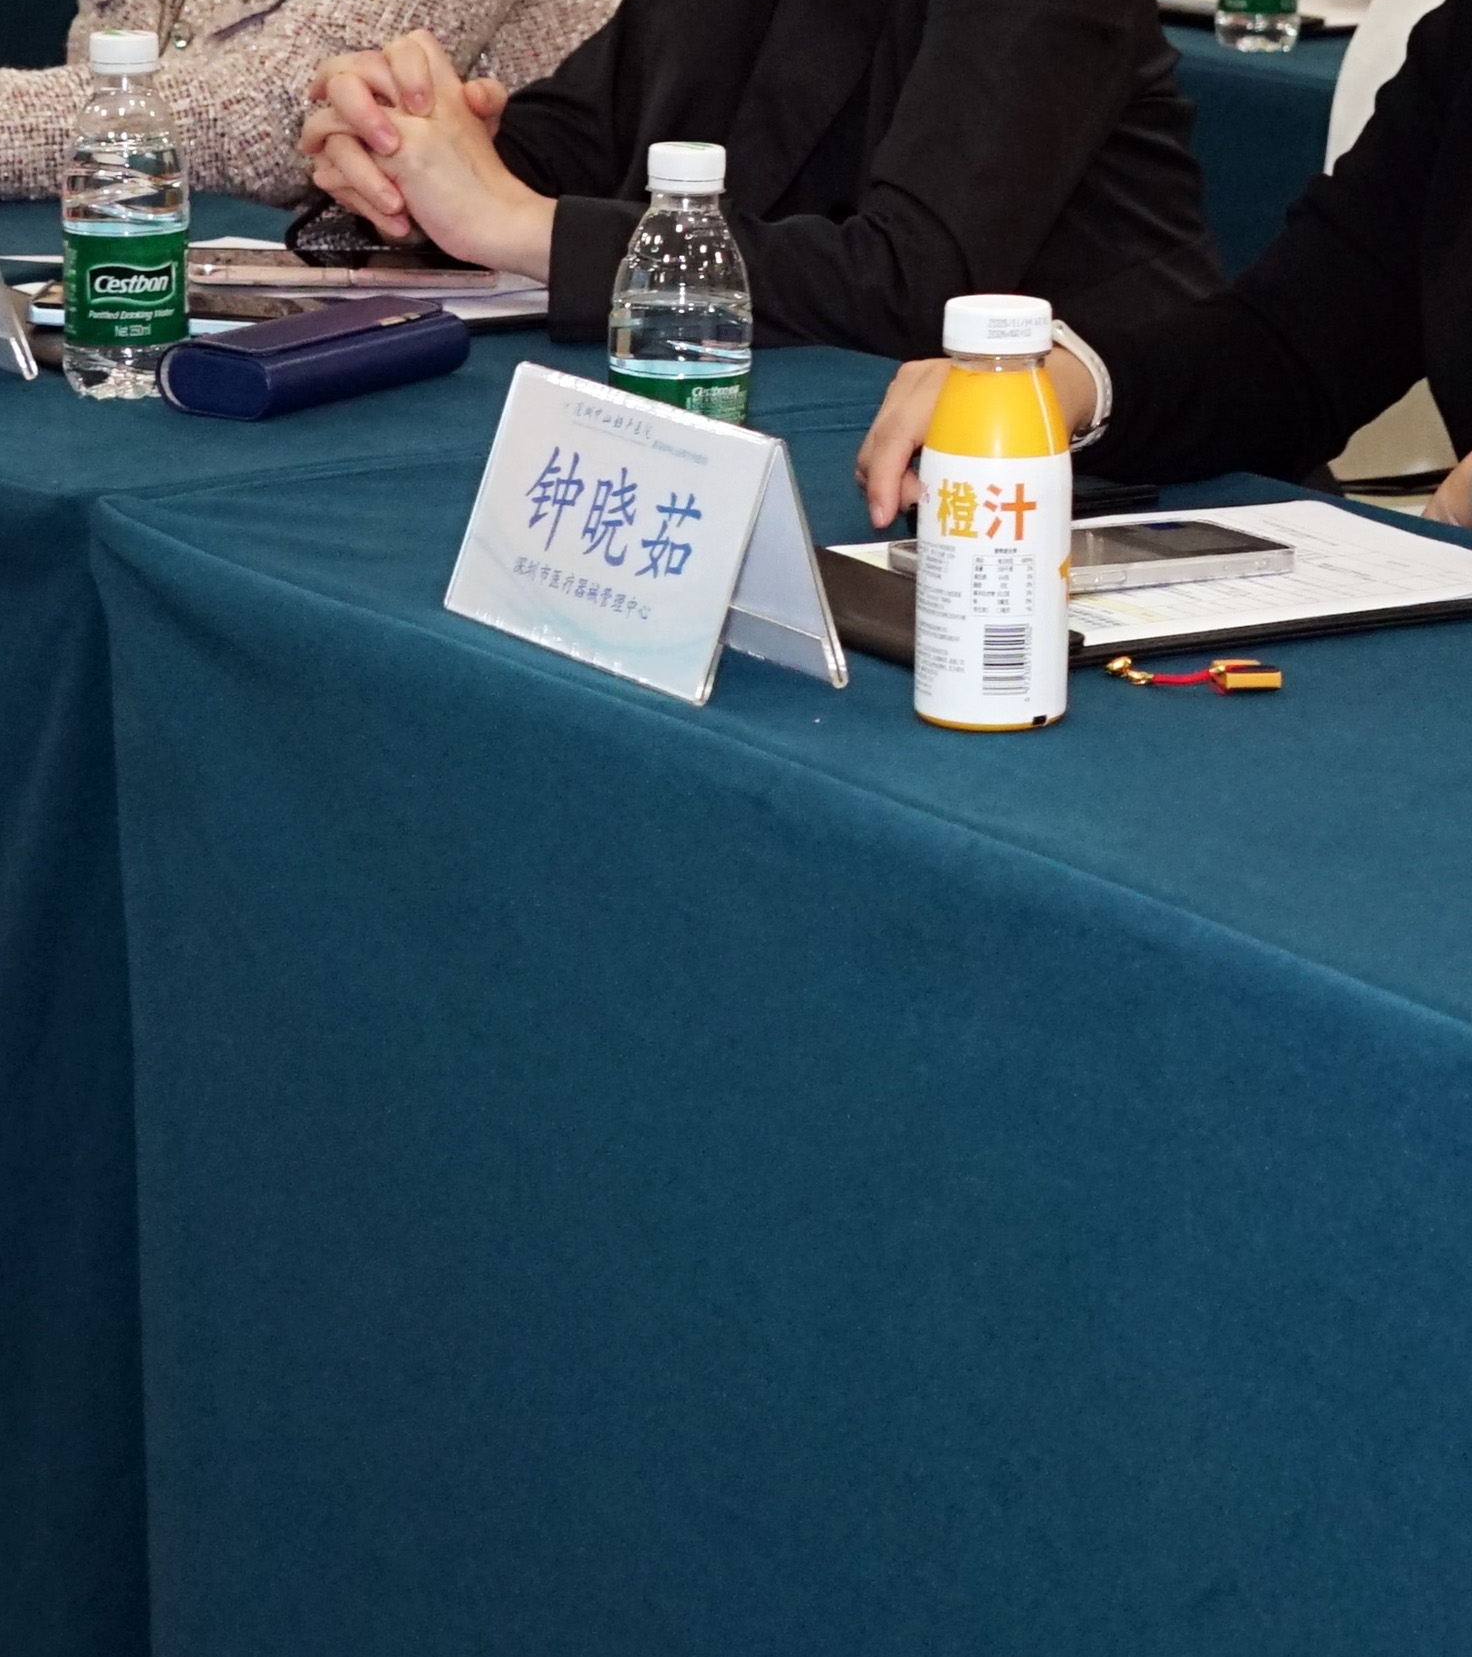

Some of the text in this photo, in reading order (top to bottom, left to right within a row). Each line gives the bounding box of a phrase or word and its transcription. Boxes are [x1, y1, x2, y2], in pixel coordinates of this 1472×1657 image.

[524, 445, 702, 580] 钟晓茹
[936, 478, 1037, 540] 橙汁
